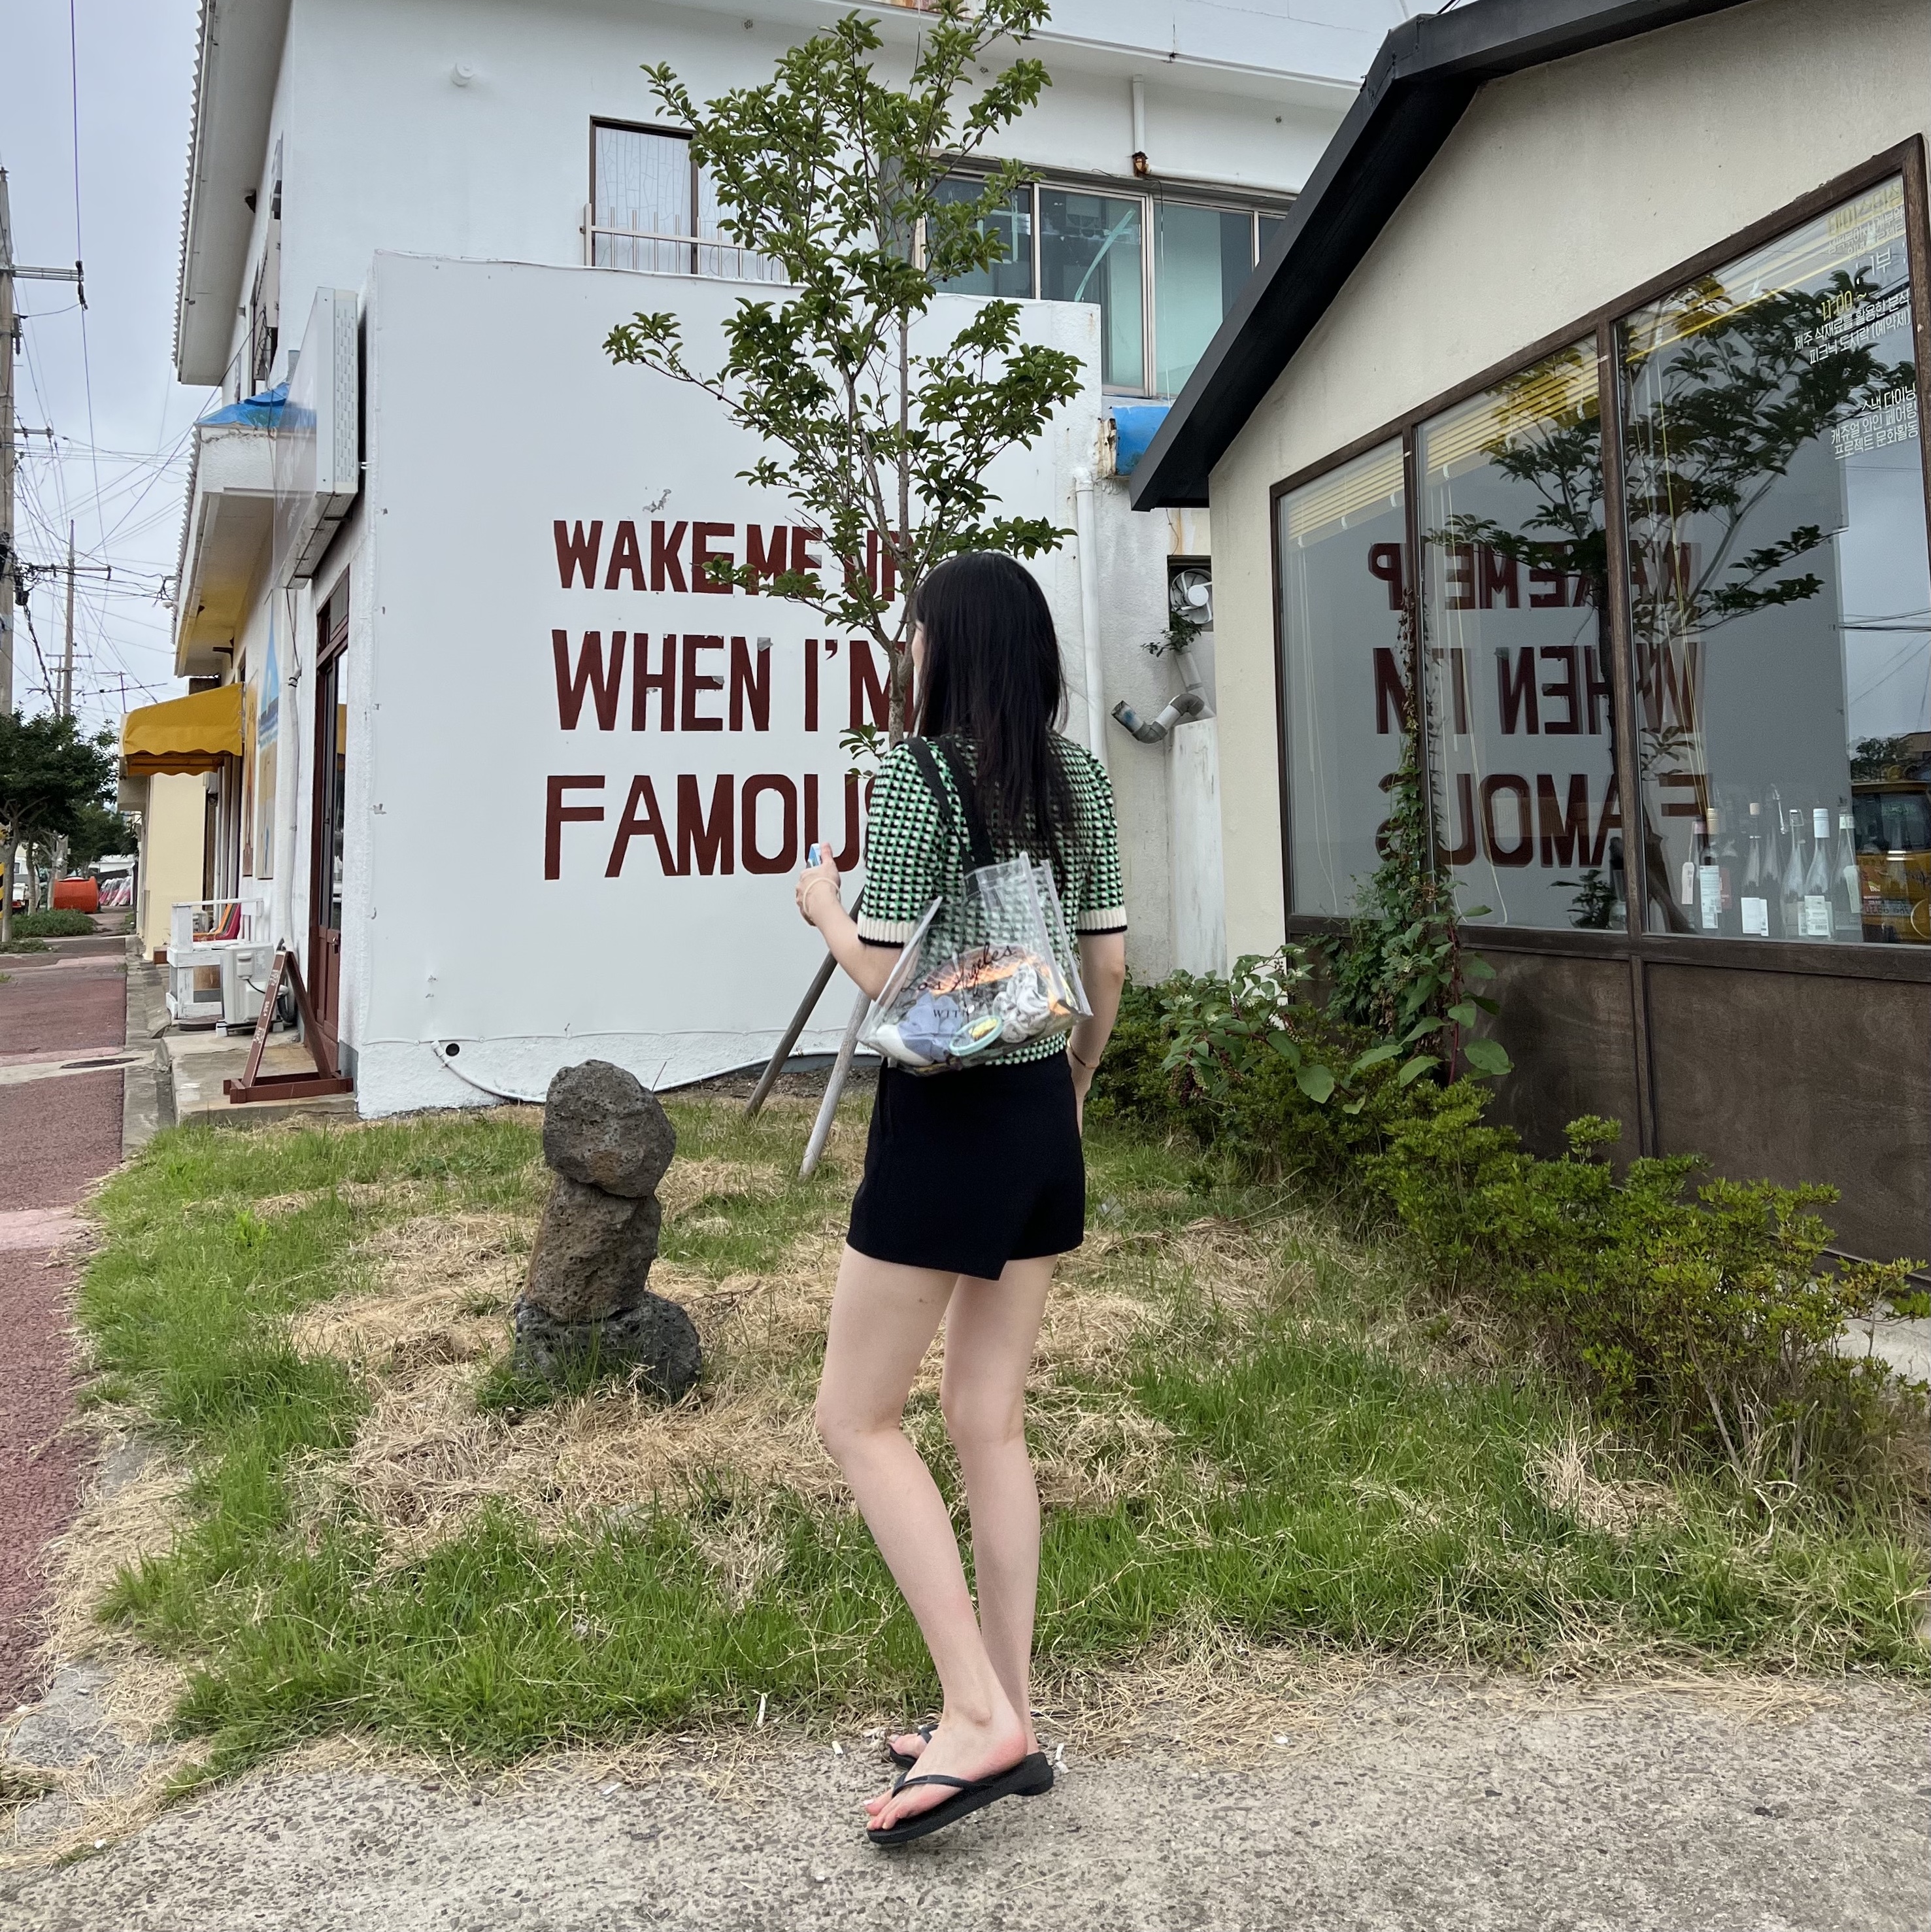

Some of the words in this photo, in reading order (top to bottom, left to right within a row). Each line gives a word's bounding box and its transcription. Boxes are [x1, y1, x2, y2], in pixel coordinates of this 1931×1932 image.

[1870, 247, 1892, 275] 1부
[1794, 330, 1813, 351] 제주
[1815, 314, 1853, 341] 식재료를
[1855, 299, 1886, 326] 활용한
[1888, 289, 1910, 311] 분식
[1821, 290, 1853, 321] 11:00
[1809, 339, 1838, 364] 피크닉
[1862, 395, 1881, 411] 스낵
[1884, 382, 1916, 409] 다이닝
[1831, 420, 1860, 445] 캐쥬얼
[1862, 413, 1883, 434] 와인
[1885, 400, 1917, 426] 페어링
[1834, 433, 1874, 460] 프로젝트
[1877, 420, 1919, 448] 문화활동
[553, 520, 735, 595] WAKE
[746, 524, 823, 596] ME
[551, 629, 771, 732] WHEN
[804, 638, 915, 732] I'M
[544, 773, 875, 880] FAMOU
